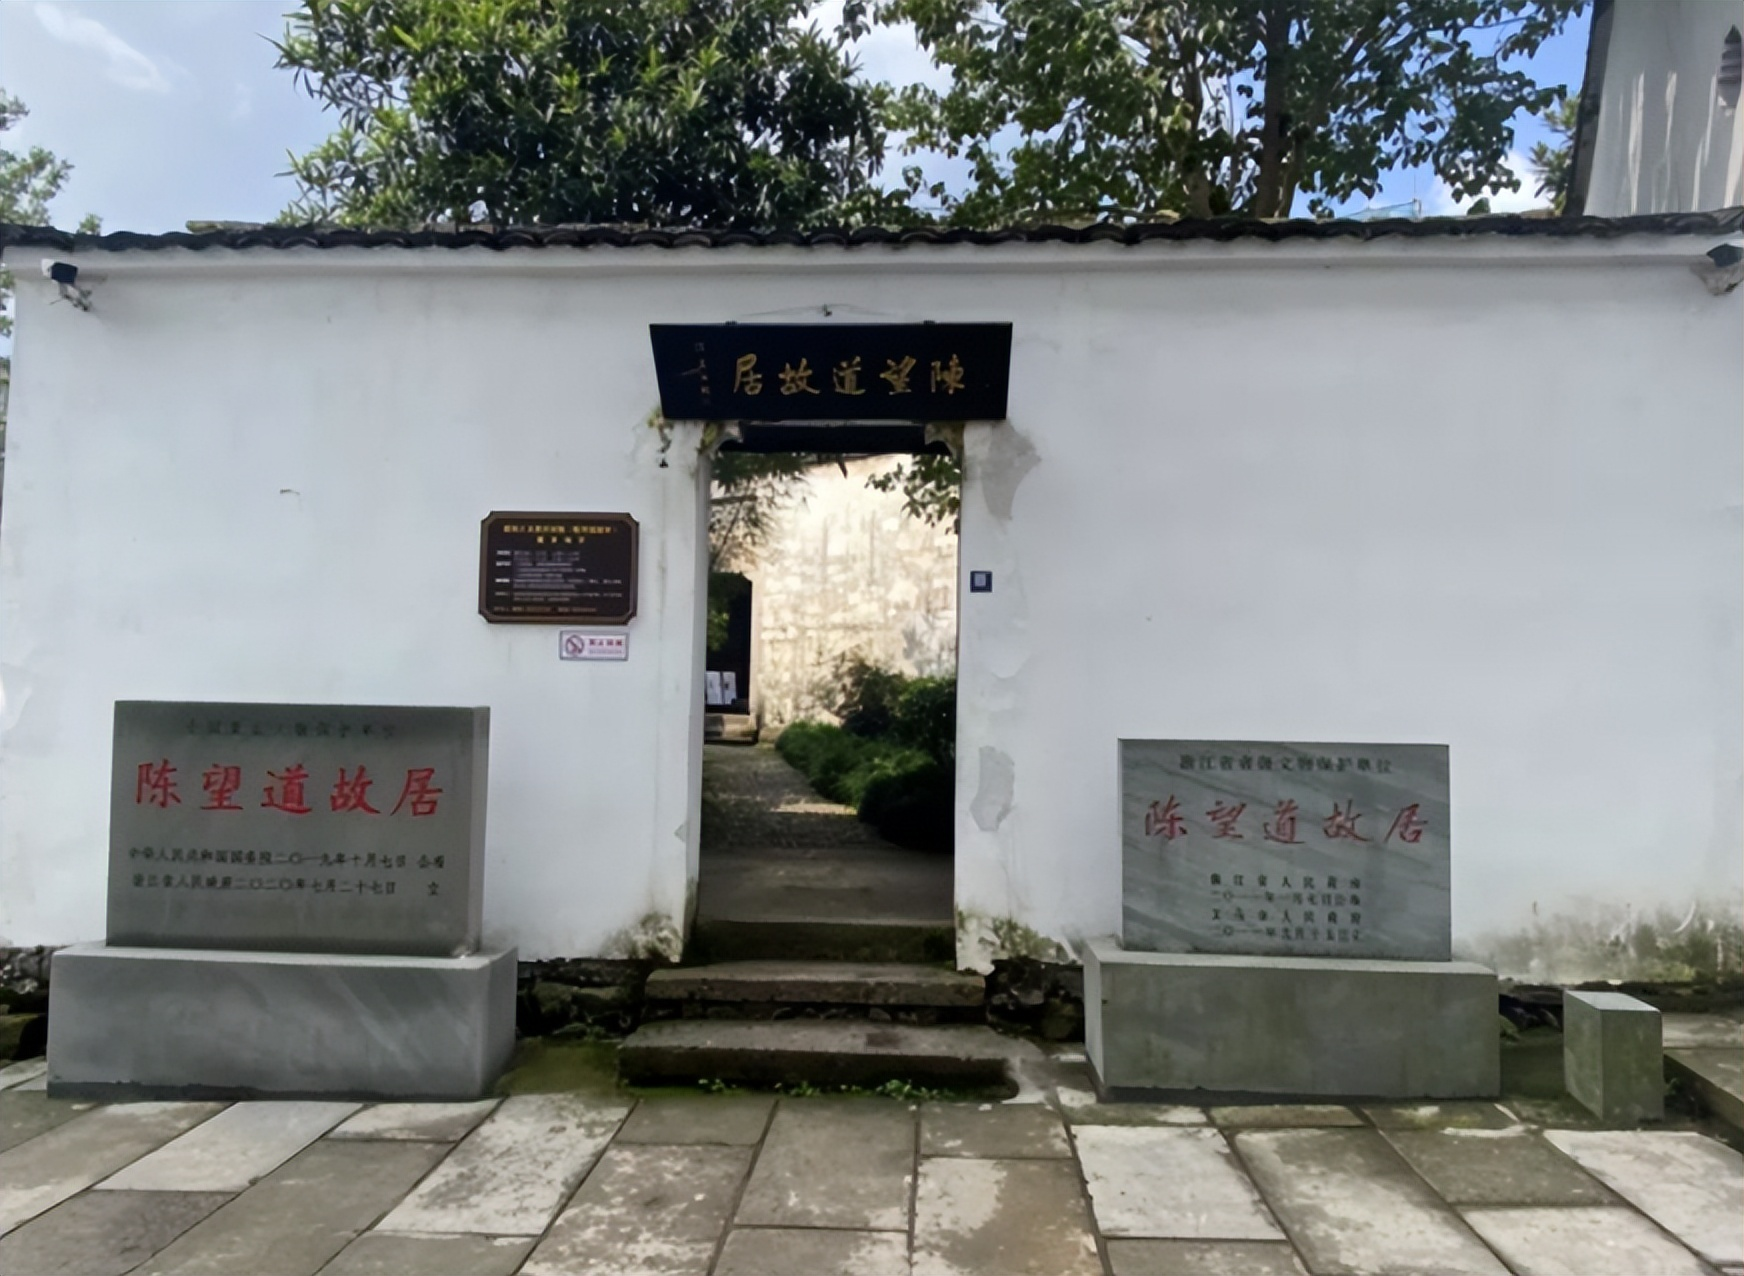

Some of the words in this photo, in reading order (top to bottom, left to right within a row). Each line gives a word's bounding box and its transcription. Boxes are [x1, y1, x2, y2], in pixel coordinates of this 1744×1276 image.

[733, 353, 965, 396] 陳望道故居
[135, 758, 444, 818] 陈望道故居
[1144, 793, 1429, 845] 陈望道故居
